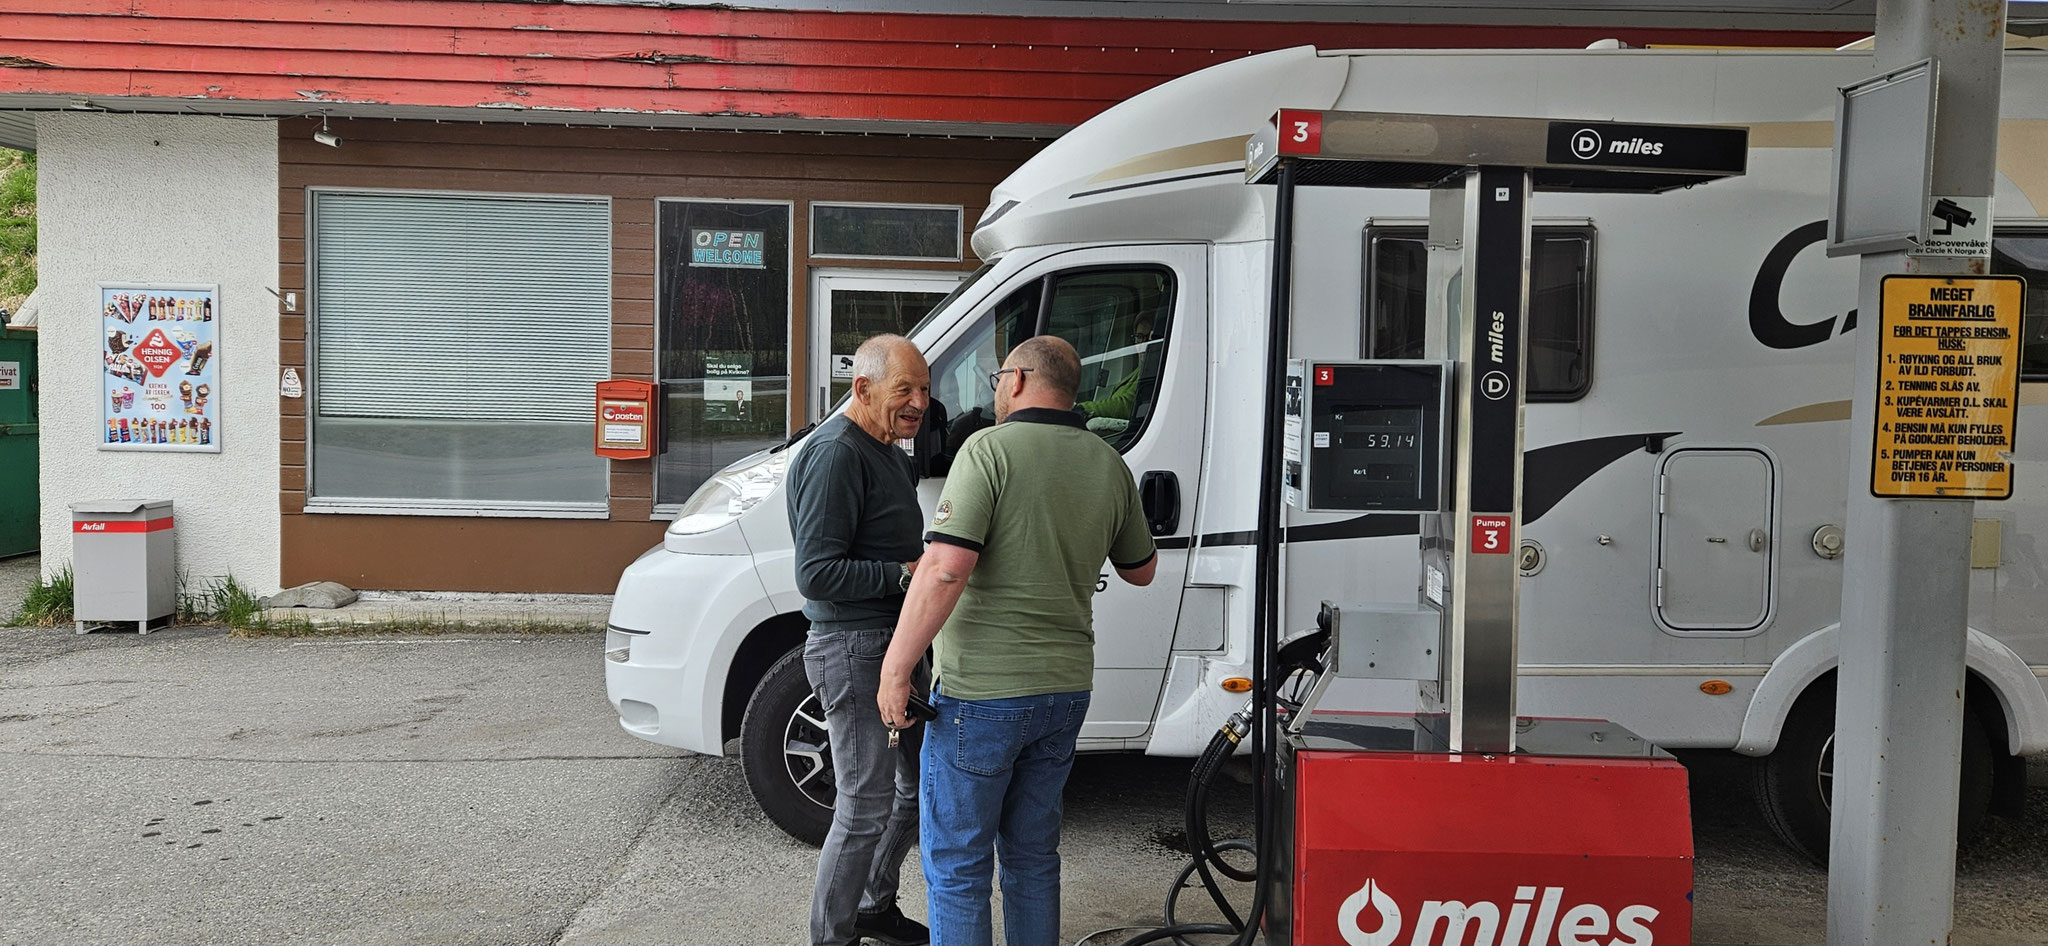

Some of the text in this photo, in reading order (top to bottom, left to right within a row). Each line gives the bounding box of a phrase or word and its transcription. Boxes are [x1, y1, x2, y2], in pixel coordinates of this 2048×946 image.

[1293, 121, 1309, 142] 3
[1609, 138, 1664, 155] miles
[696, 231, 760, 248] OPEN
[693, 248, 762, 264] WELCOME
[1930, 287, 1974, 301] MEGET
[1908, 303, 1995, 317] BRANNFARLIG
[1489, 310, 1505, 364] miles
[1894, 326, 2011, 339] FØR DET TAPPES BENSIN,
[1938, 338, 1966, 350] HUSK:
[144, 355, 170, 363] OLSEN
[1886, 354, 2003, 366] 1. RØYKING OG ALL BRUK
[1320, 371, 1329, 381] 3
[1898, 366, 1977, 377] AV ILD FORBUDT.
[1885, 380, 1981, 392] 2. TENNING SLÅS AV.
[1884, 395, 2008, 408] 3. KUPÉVARMER O.L. SKAL
[1897, 407, 1969, 418] VÆRE AVSLÅTT.
[1882, 422, 2003, 435] 4. BENSIN MÅ KUN FYLLES
[1893, 434, 2008, 446] PÅ GODKJENT BEHOLDER.
[1881, 449, 1976, 461] 5. PUMPER KAN KUN
[1892, 460, 2005, 472] BETJENES AV PERSONER
[1891, 471, 1948, 482] OVER 16 ÅR.
[81, 522, 106, 531] Avfall
[1476, 519, 1506, 528] Pumpe
[1483, 530, 1499, 550] 3
[1410, 886, 1660, 946] miles
